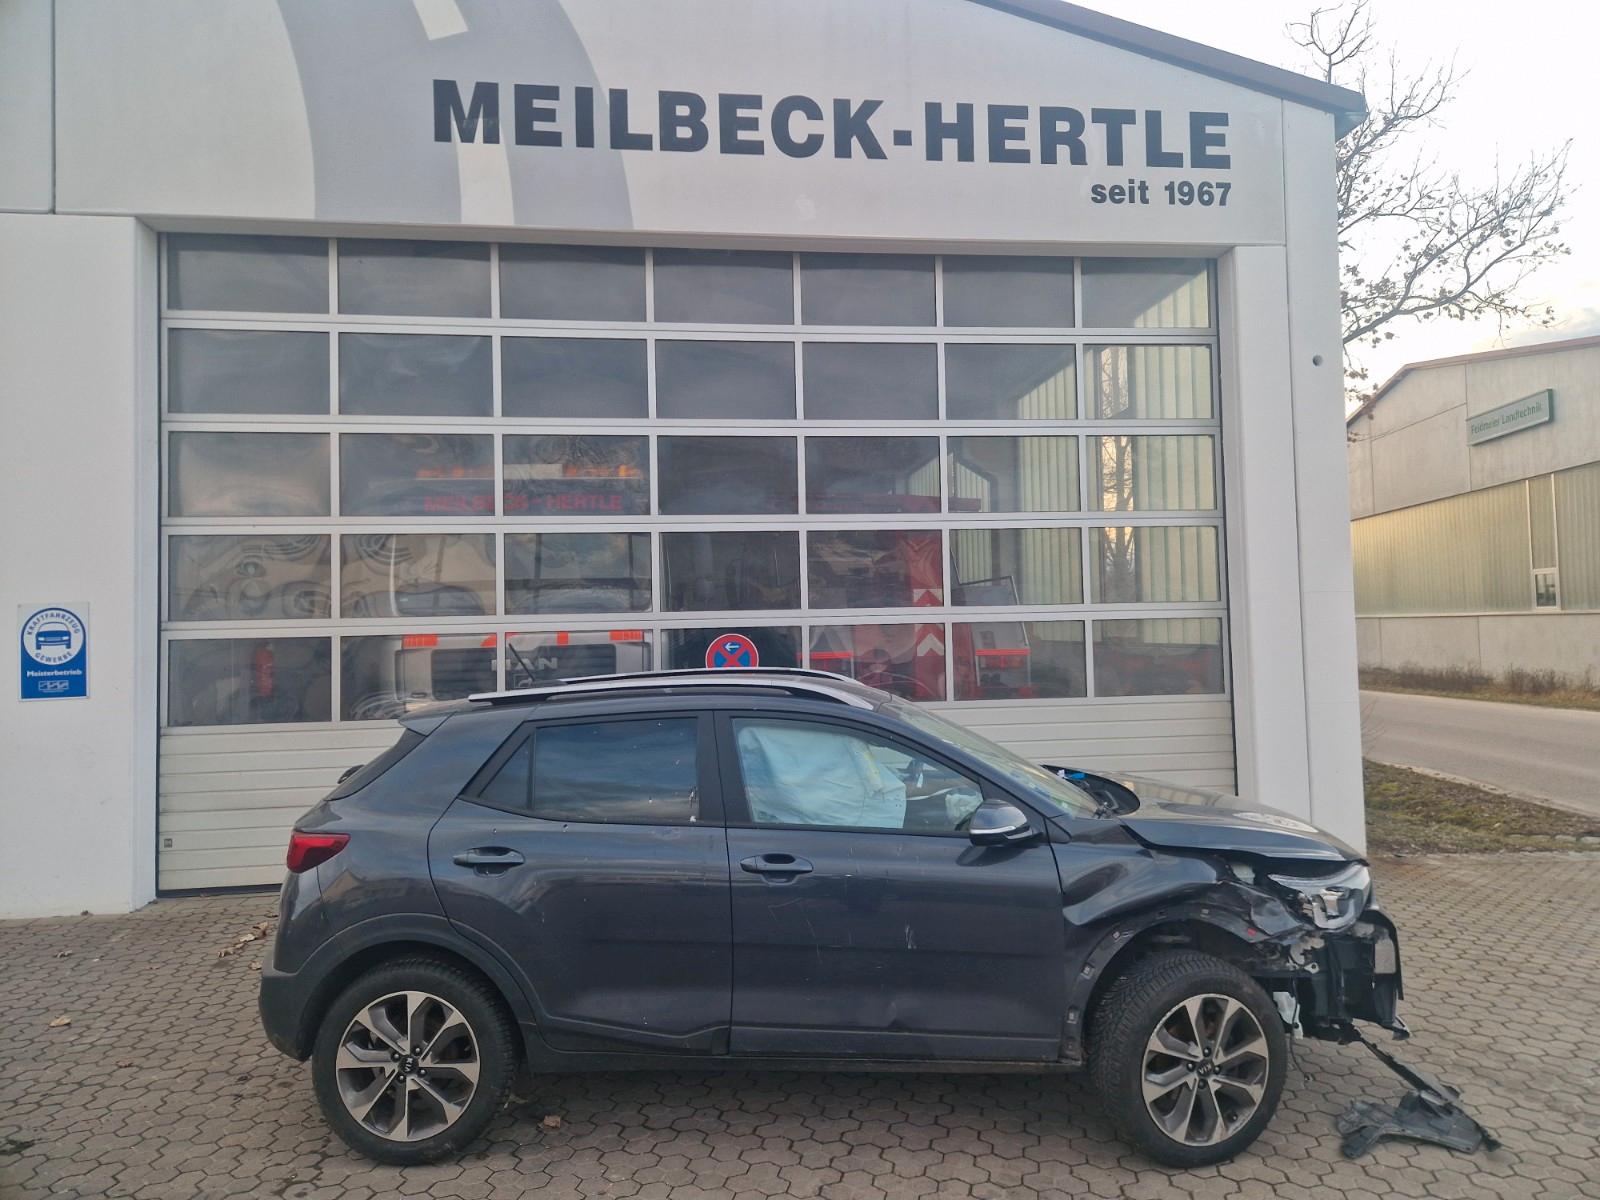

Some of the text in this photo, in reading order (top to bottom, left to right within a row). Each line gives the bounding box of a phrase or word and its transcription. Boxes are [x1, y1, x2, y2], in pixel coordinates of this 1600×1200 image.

[432, 78, 1231, 170] MEILBECK-HERTLE
[1091, 178, 1232, 206] seit 1967
[1501, 401, 1542, 425] Landtechnik
[27, 612, 80, 636] KRAFTFAHRZEUG
[26, 669, 82, 677] Meisterbetrieb
